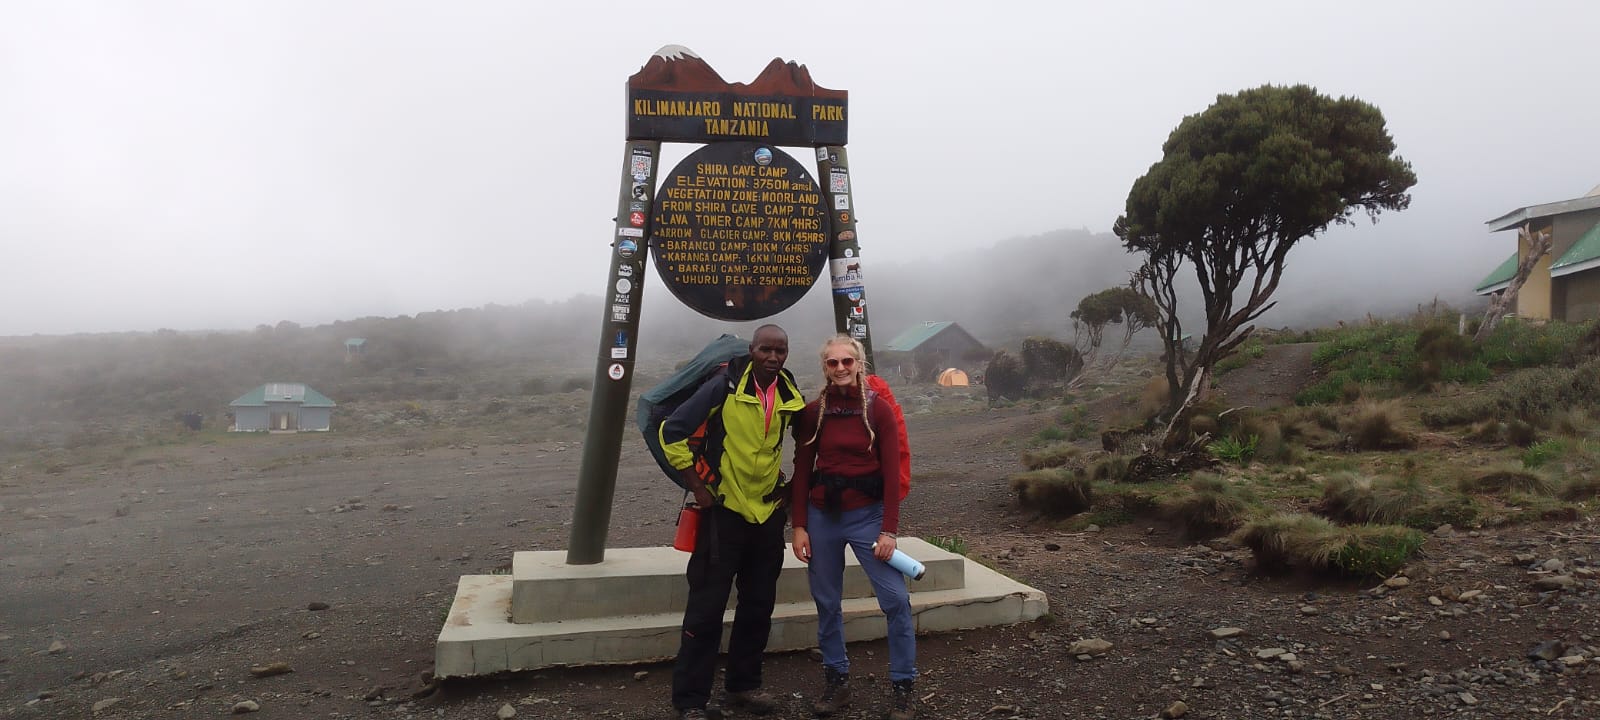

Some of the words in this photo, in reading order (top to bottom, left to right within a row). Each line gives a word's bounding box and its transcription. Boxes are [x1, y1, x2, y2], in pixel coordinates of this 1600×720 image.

[634, 99, 721, 117] KILIMANJARO
[733, 102, 797, 120] NATIONAL
[812, 104, 844, 121] PARK
[705, 119, 769, 137] TANZANIA
[697, 163, 729, 175] SHIRA
[732, 165, 756, 177] CAVE
[758, 166, 788, 178] CAMP
[677, 175, 750, 188] ELEVATION:
[753, 178, 790, 191] 3750M
[667, 188, 731, 201] VEGETATION
[662, 201, 692, 212] FROM
[694, 202, 727, 213] SHIRA
[731, 204, 757, 215] CAVE
[764, 205, 794, 216] CAMP
[661, 214, 688, 225] LAVA
[695, 214, 732, 227] TOWER
[735, 216, 765, 229] CAMP
[660, 228, 692, 238] ARROW
[700, 228, 741, 240] GLACIER
[667, 252, 710, 263] KARANGA
[678, 264, 717, 274] BARAFU
[682, 275, 719, 285] UHURU
